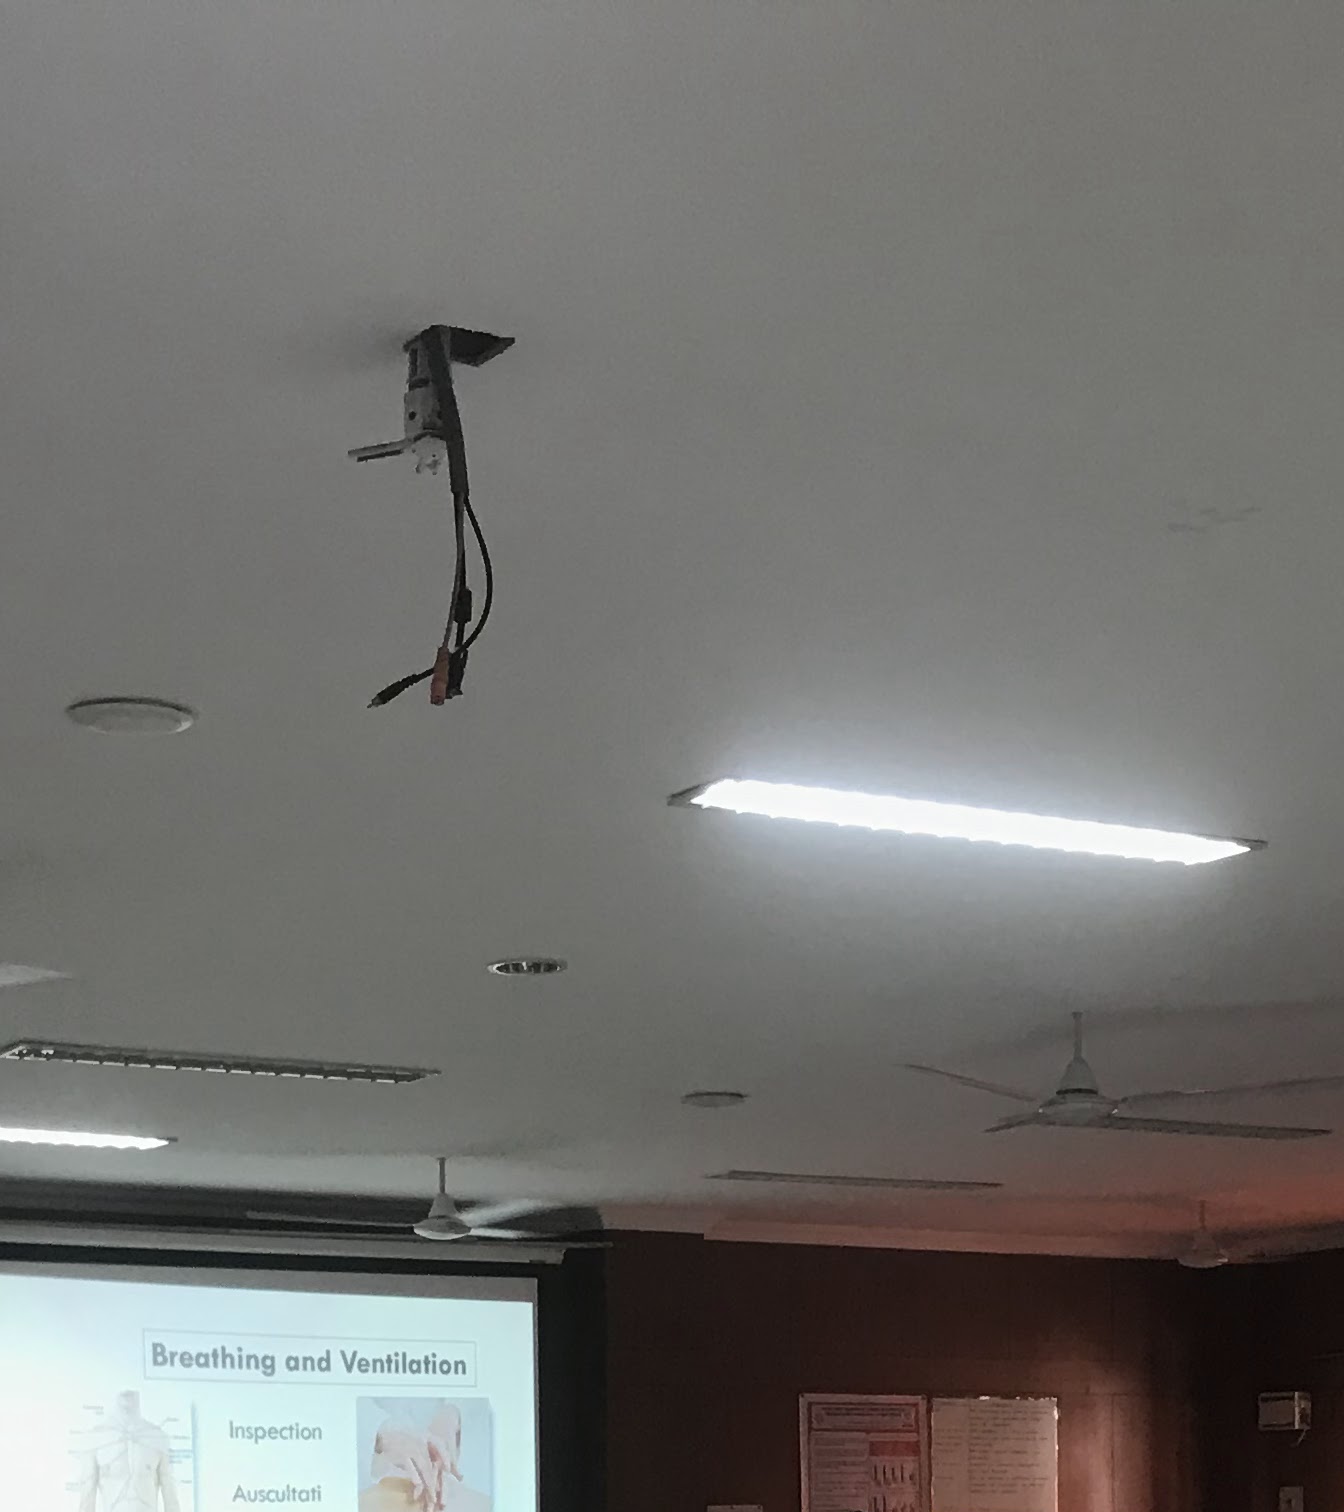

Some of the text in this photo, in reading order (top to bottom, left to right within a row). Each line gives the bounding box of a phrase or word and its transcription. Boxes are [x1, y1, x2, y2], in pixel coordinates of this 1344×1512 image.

[151, 1341, 467, 1377] Breathing and Ventilation
[229, 1420, 323, 1445] Inspection
[232, 1484, 323, 1503] Auscultati
